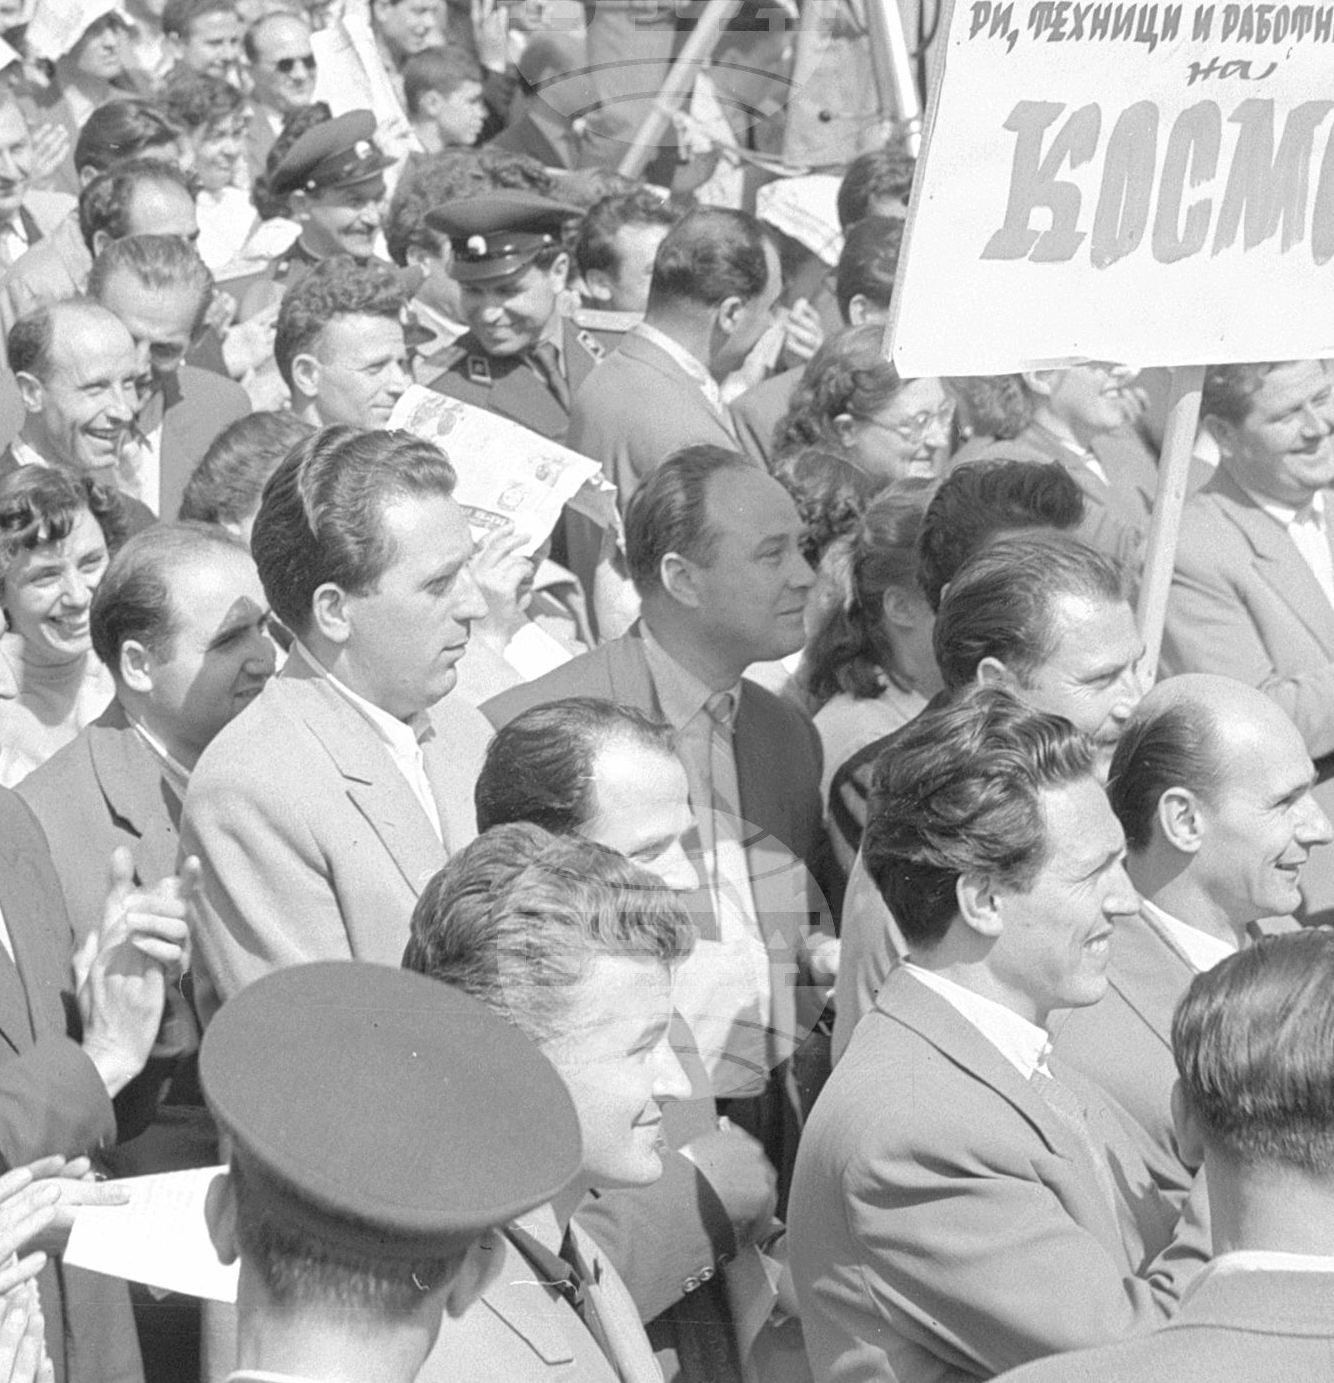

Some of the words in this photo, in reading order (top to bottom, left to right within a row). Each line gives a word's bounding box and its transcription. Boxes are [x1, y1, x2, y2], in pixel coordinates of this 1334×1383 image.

[967, 0, 1018, 54] РИ,
[1027, 0, 1181, 54] ТЕХНИЦИ
[1191, 3, 1215, 43] И
